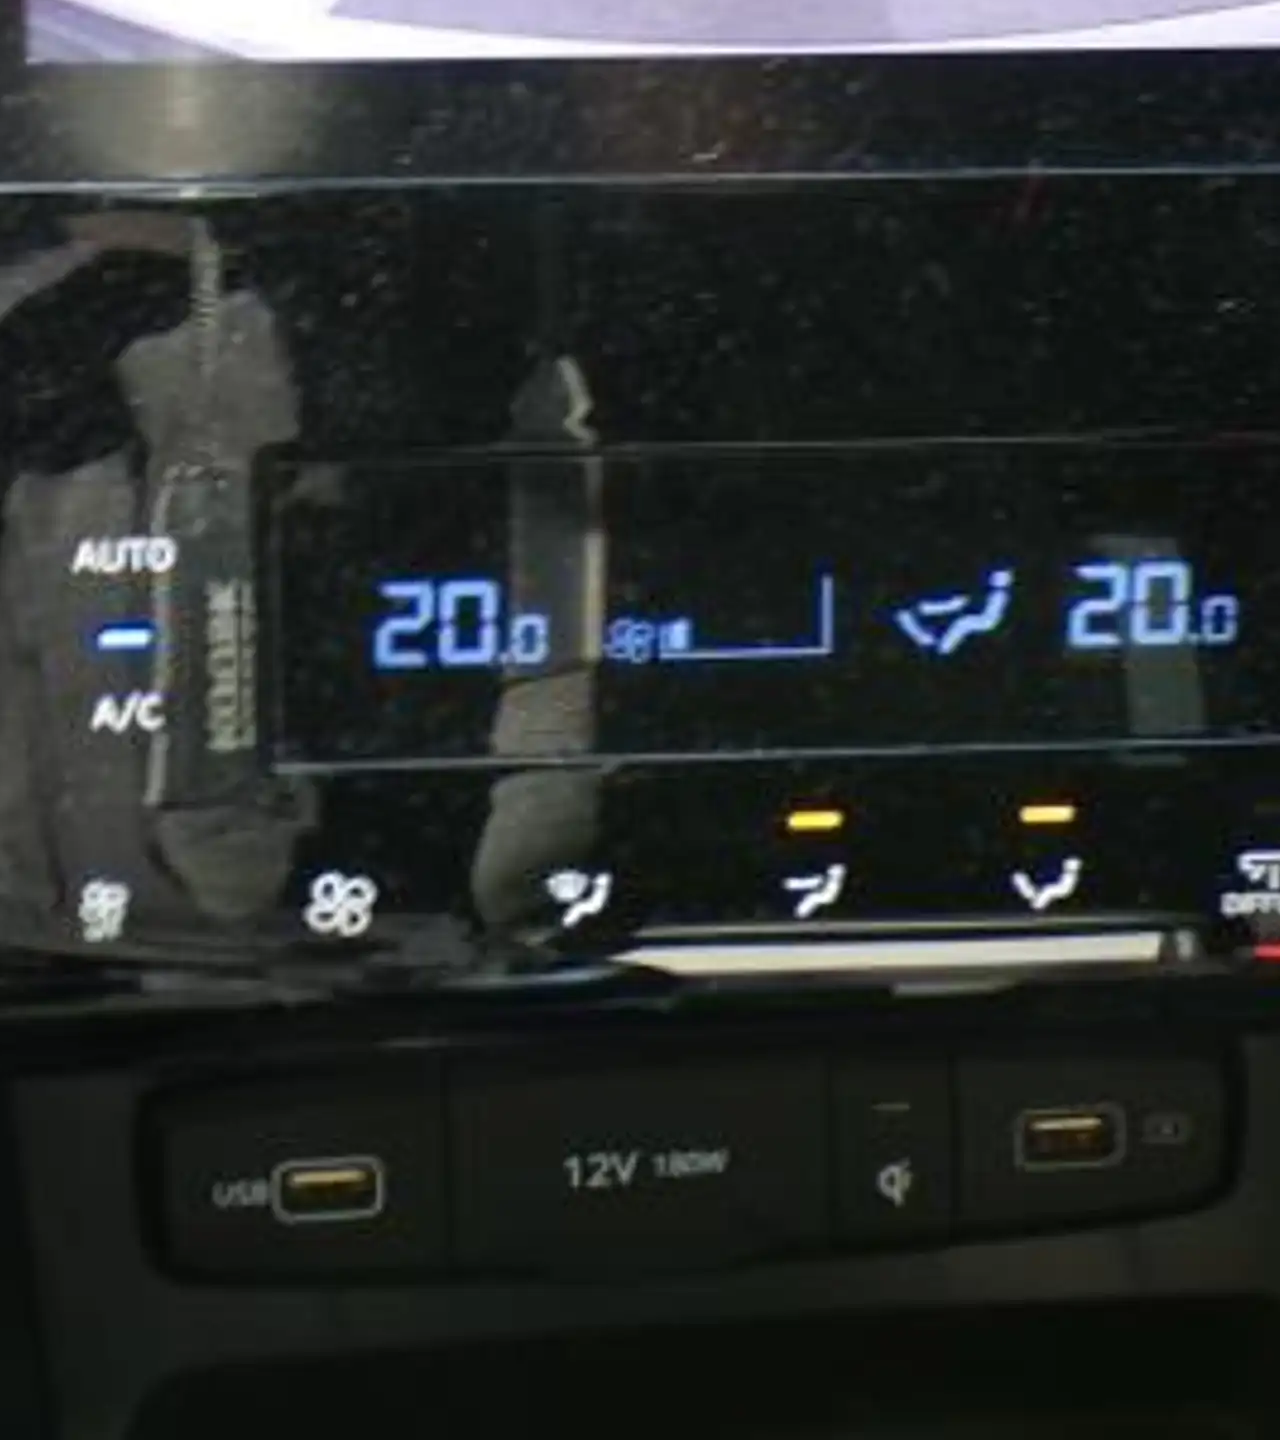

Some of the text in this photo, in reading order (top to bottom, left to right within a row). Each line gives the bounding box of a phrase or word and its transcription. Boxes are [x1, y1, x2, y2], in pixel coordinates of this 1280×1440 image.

[72, 537, 178, 575] AUTO
[371, 578, 551, 670] 20.0
[1066, 560, 1240, 648] 20.0
[90, 692, 167, 734] A/C
[562, 1148, 640, 1191] 12V
